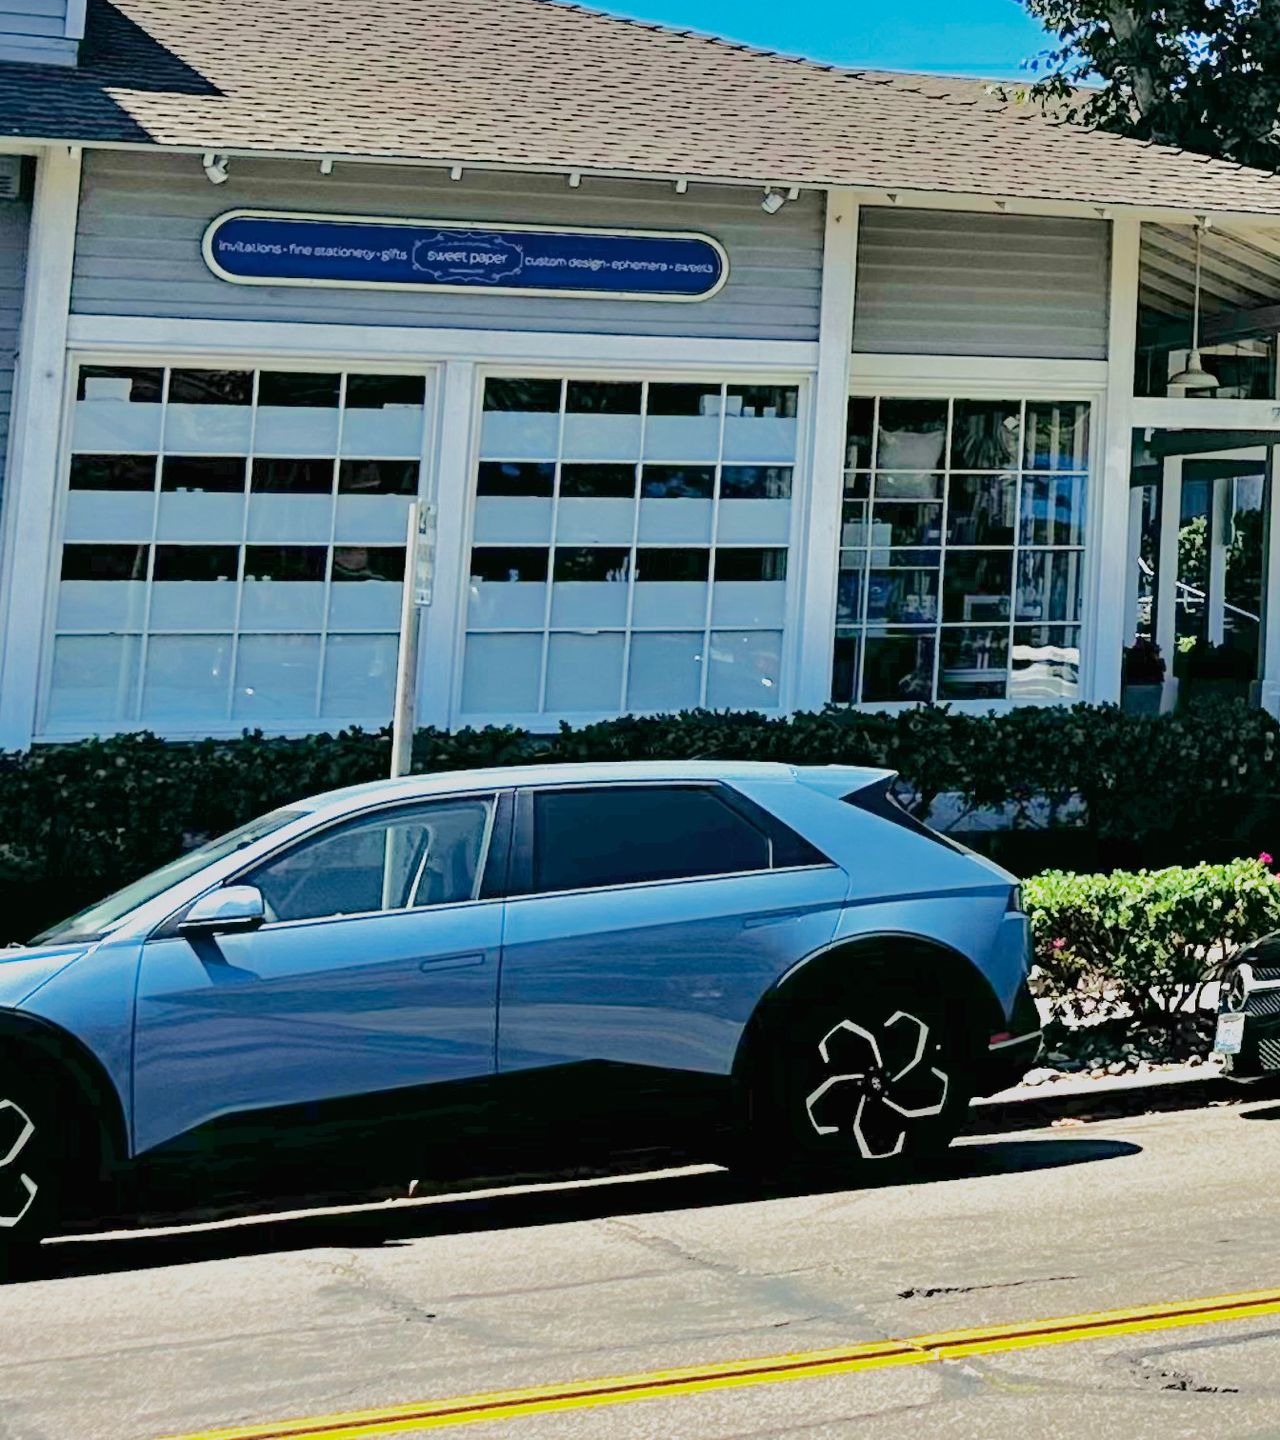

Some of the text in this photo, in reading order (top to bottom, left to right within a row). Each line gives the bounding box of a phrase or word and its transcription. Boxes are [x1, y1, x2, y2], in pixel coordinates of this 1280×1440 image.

[218, 239, 408, 261] invitations fine stationery gifts
[427, 250, 508, 266] sweet paper
[525, 256, 567, 267] custom
[568, 257, 606, 272] design
[611, 260, 667, 272] ephemera
